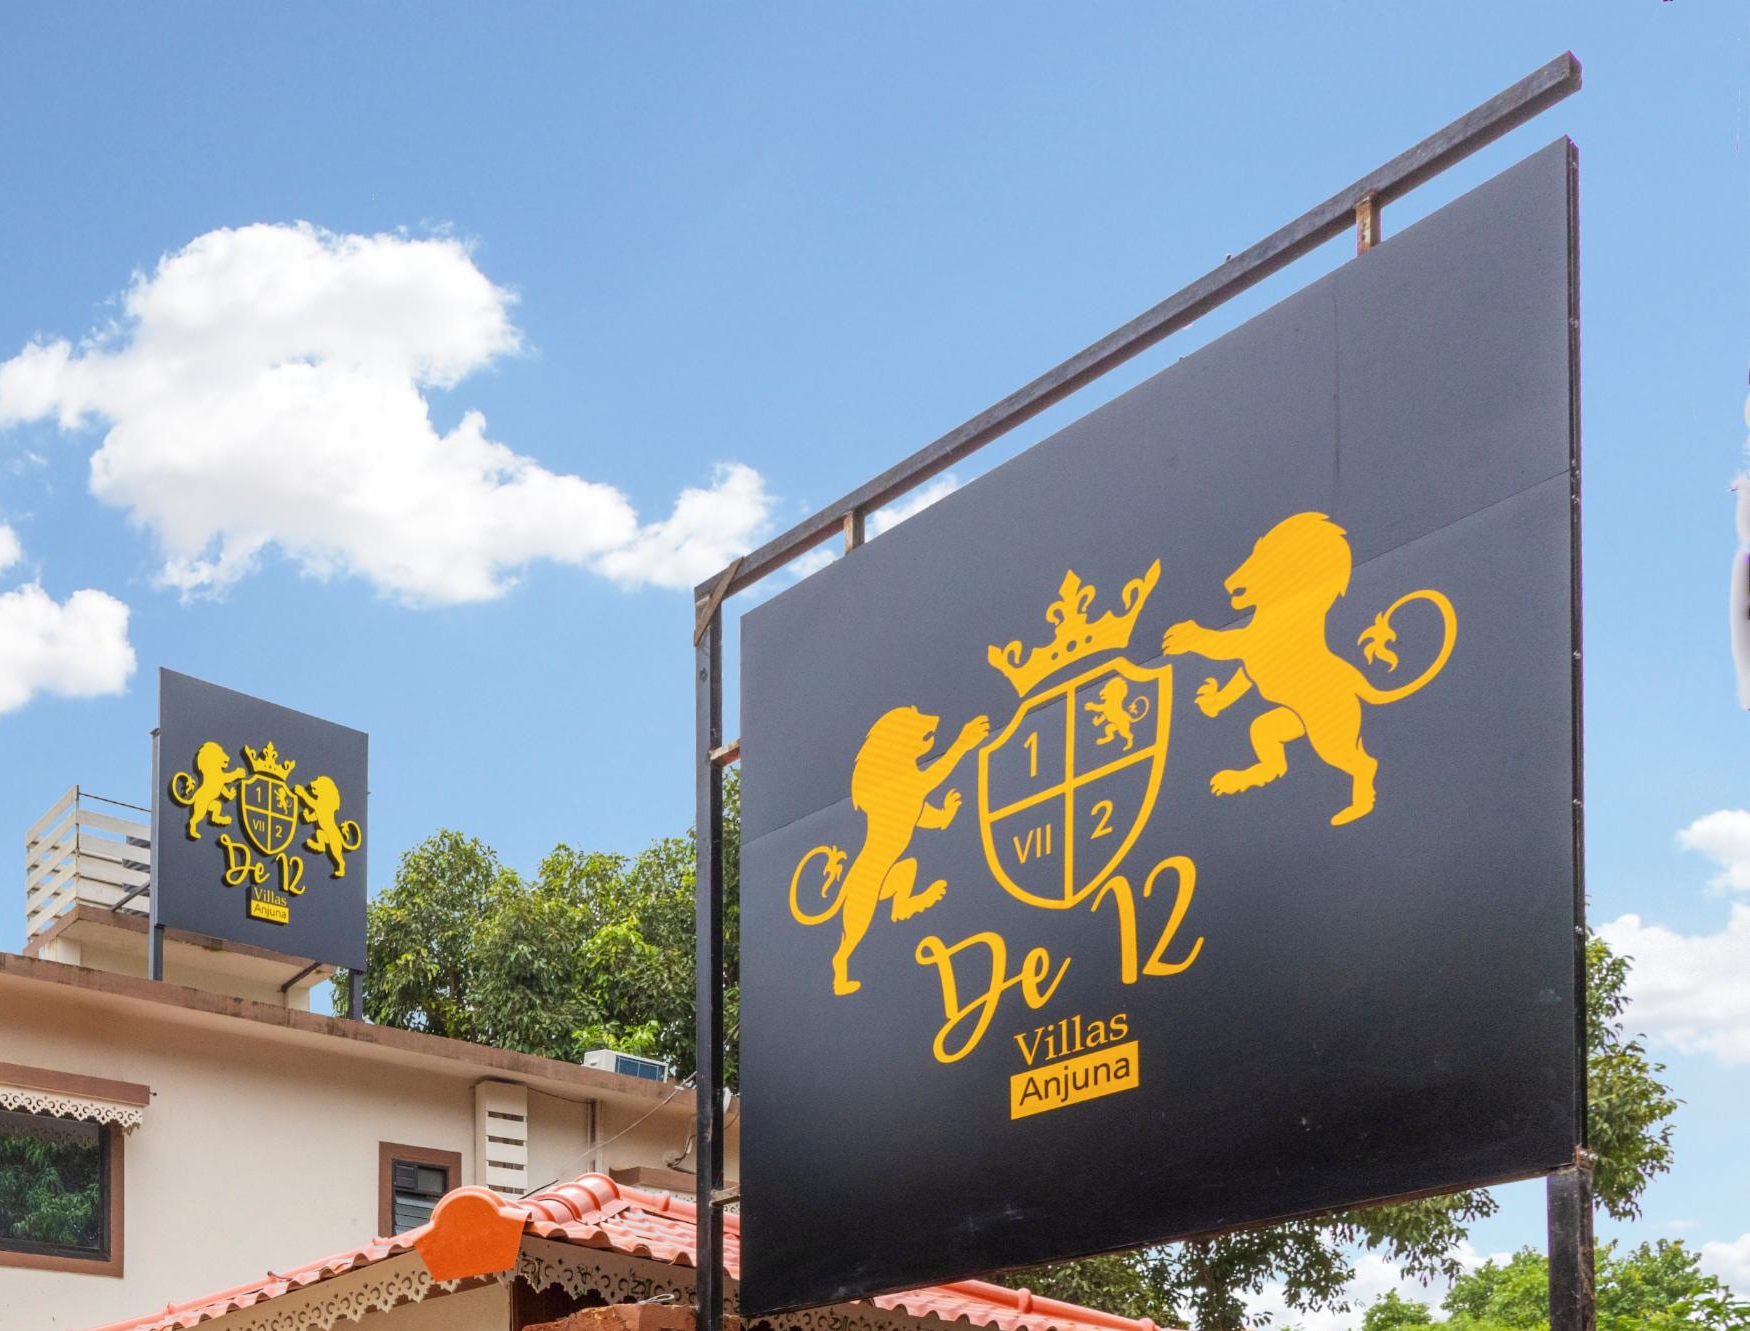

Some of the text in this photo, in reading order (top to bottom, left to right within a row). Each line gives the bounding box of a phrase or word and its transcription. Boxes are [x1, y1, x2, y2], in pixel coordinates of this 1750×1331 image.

[1024, 731, 1039, 778] 1
[256, 786, 262, 802] 1
[252, 819, 265, 833] VII
[275, 824, 283, 838] 2
[1090, 799, 1114, 840] 2
[220, 833, 306, 895] De 12
[1013, 823, 1052, 865] VII
[253, 886, 288, 907] Villas
[253, 902, 287, 919] Anjuna
[915, 855, 1205, 1064] De 12
[1013, 1013, 1130, 1066] Villas
[1019, 1056, 1132, 1106] Anjuna
